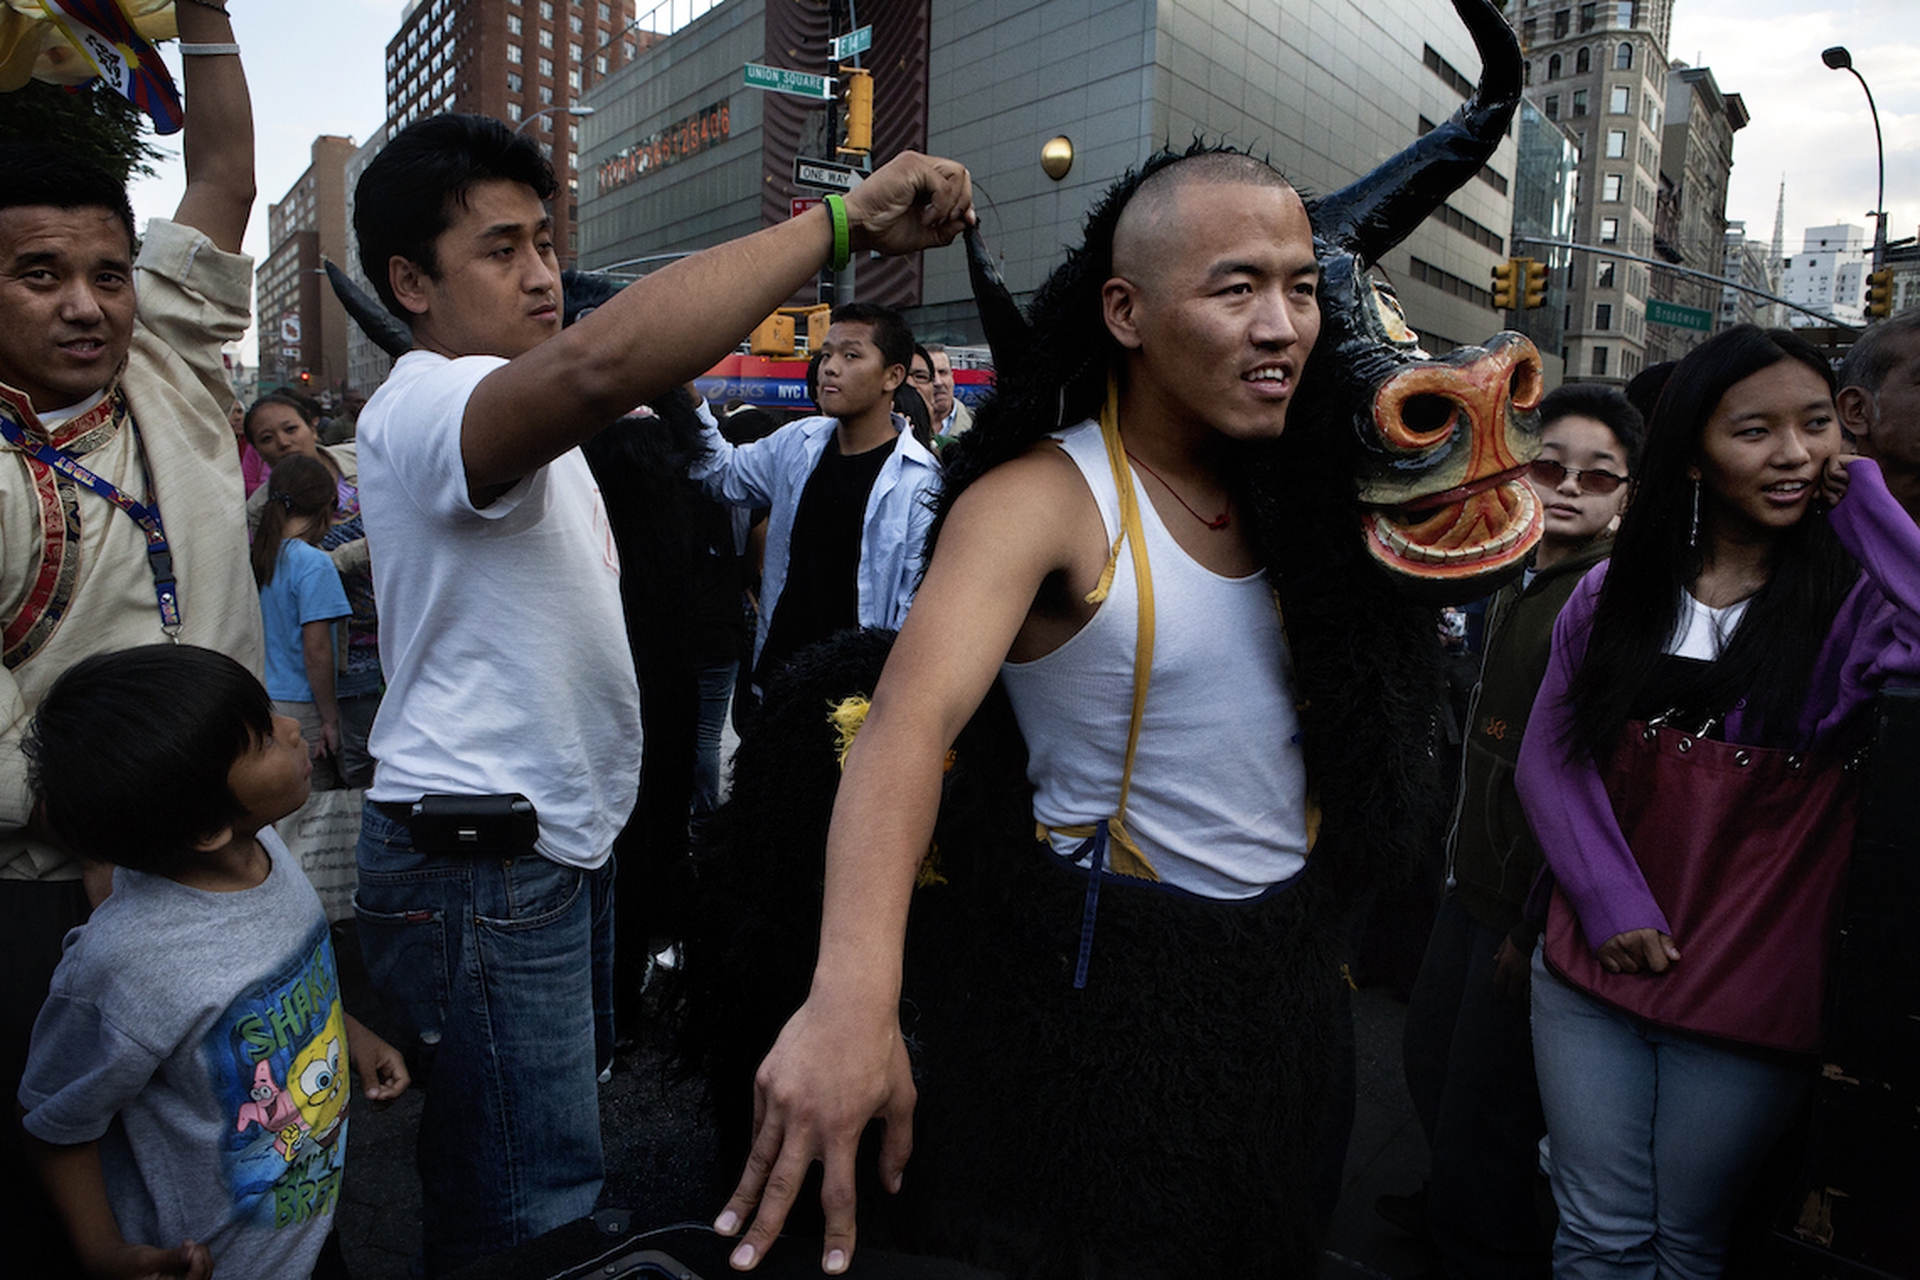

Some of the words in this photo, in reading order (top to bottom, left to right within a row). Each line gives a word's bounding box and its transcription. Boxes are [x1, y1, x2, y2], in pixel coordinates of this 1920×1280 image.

[841, 38, 847, 55] E
[849, 34, 859, 51] 14
[747, 66, 779, 81] UNION
[782, 71, 822, 89] SQUARE
[803, 166, 824, 181] ONE
[828, 172, 849, 184] WAY
[1654, 305, 1702, 328] Broadway
[727, 384, 766, 398] asics
[778, 385, 801, 399] NYC
[54, 456, 97, 488] TIBET
